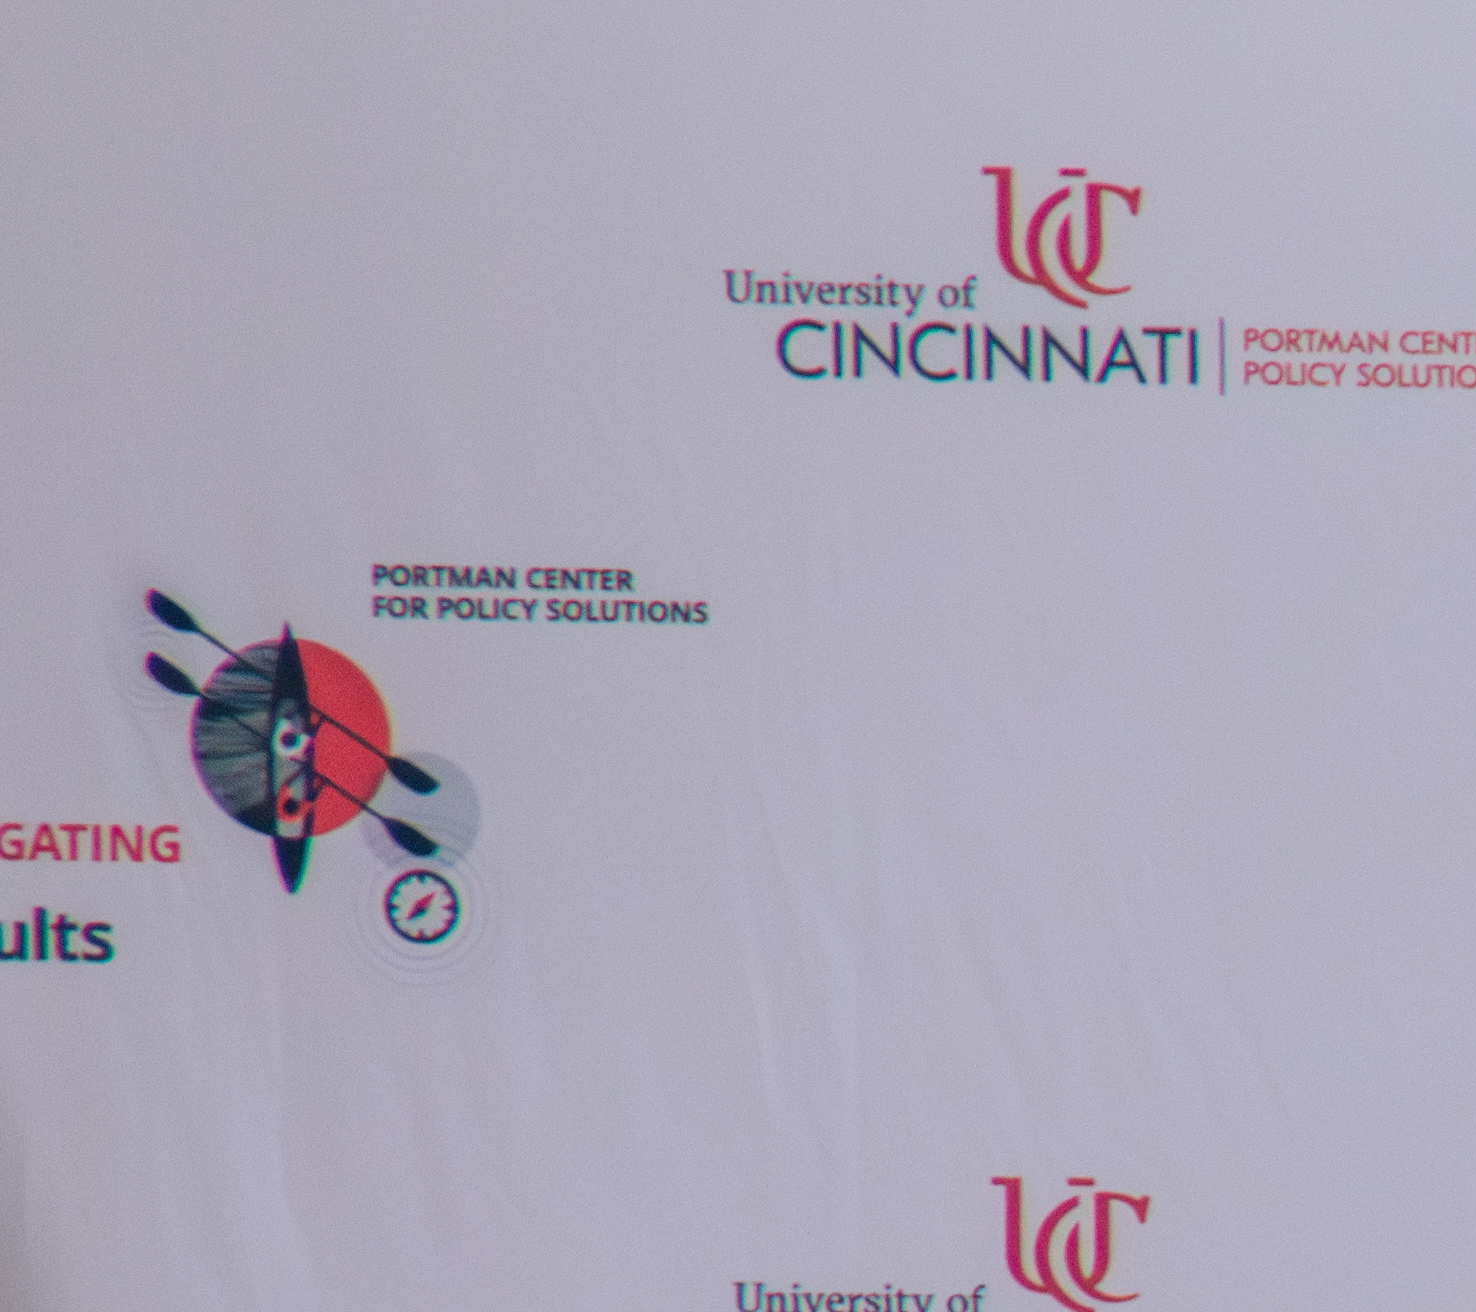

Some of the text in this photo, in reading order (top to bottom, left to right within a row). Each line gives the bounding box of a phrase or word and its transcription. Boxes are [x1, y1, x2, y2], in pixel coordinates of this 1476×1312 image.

[722, 269, 979, 315] University of
[775, 320, 1201, 387] CINCINNATI
[1243, 327, 1391, 356] PORTMAN
[1243, 360, 1347, 388] POLICY
[371, 563, 635, 592] PORTMAN CENTER
[371, 597, 710, 626] FOR POLICY SOLUTIONS
[0, 822, 181, 864] GATING
[0, 906, 116, 964] ults
